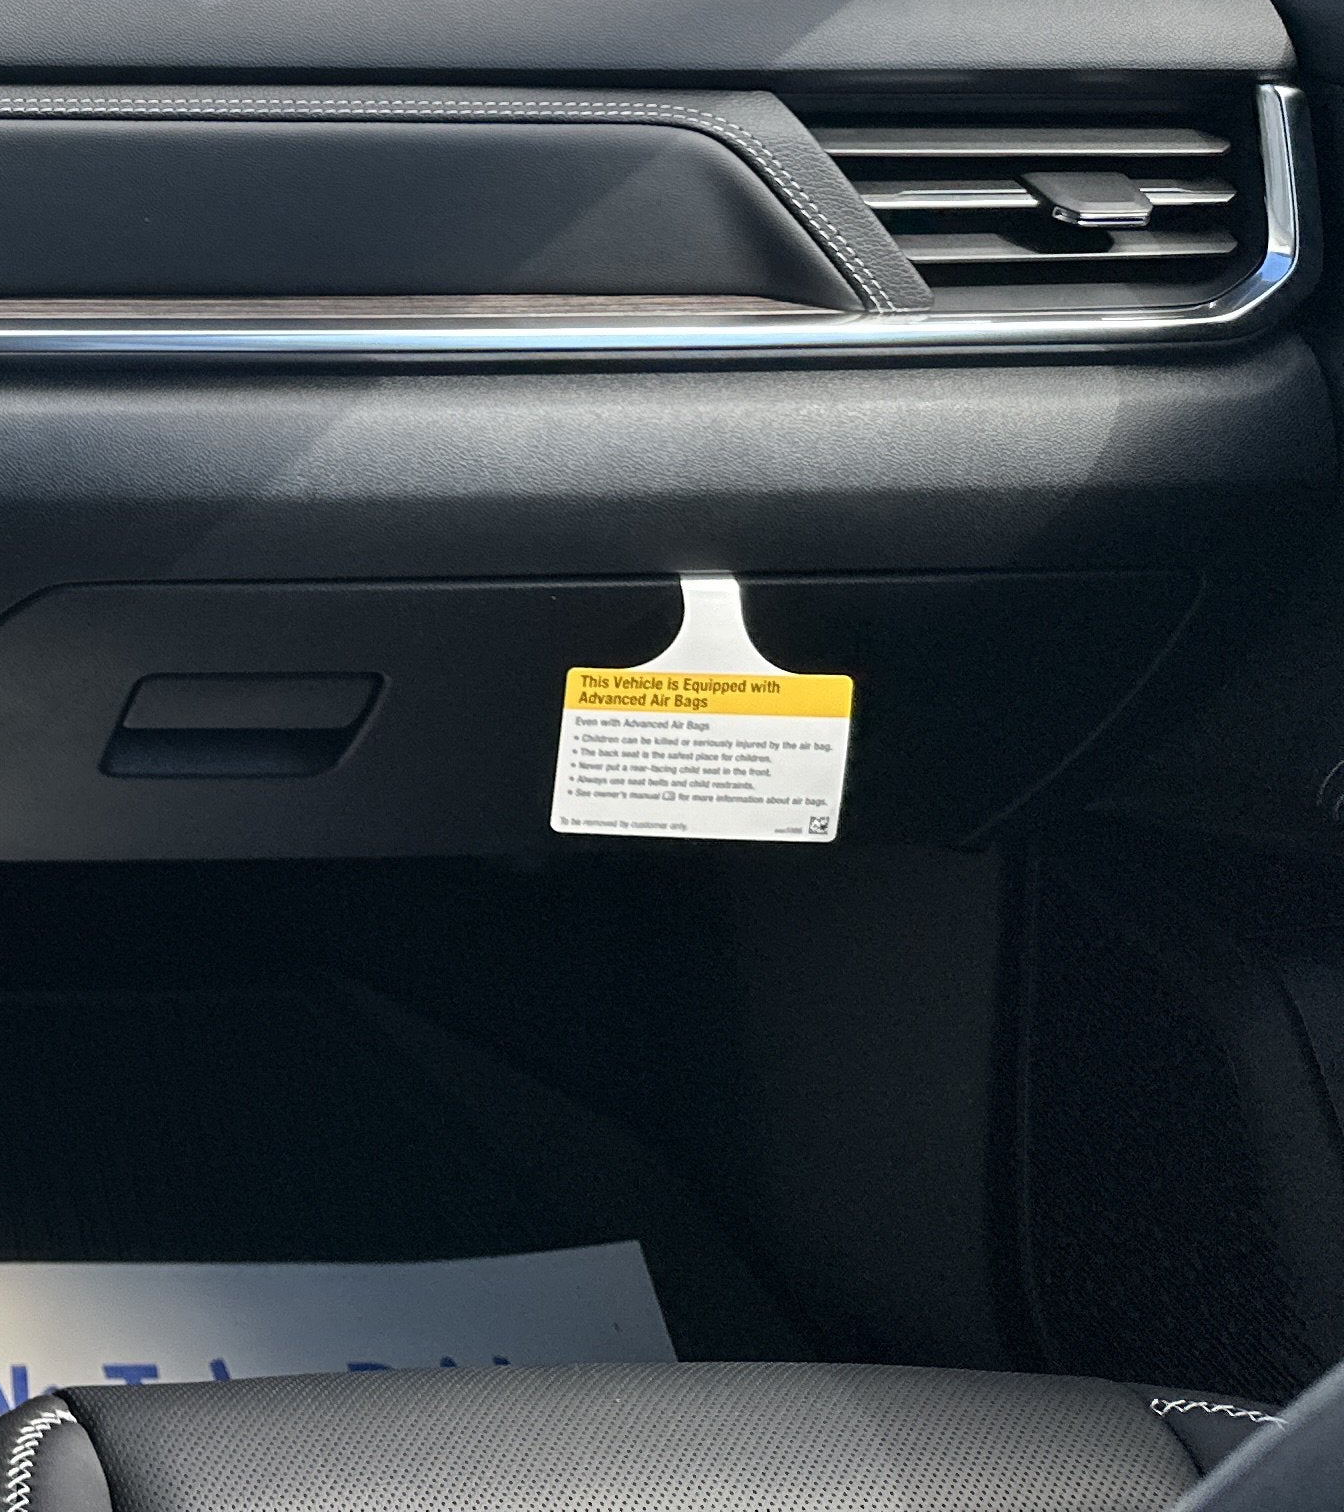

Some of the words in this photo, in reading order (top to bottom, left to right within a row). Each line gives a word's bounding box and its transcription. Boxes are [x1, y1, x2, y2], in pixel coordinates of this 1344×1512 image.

[581, 675, 609, 688] This
[613, 676, 663, 690] Vehicle
[667, 678, 679, 691] is
[683, 678, 746, 695] Equipped
[751, 680, 780, 694] with
[578, 692, 646, 706] Advanced
[650, 694, 671, 707] Air
[674, 695, 708, 710] Bags
[575, 717, 598, 726] Even
[600, 719, 621, 727] with
[623, 719, 668, 729] Advanced
[671, 720, 684, 729] Air
[686, 721, 710, 732] Bags
[582, 734, 619, 743] Children
[621, 736, 638, 744] can
[640, 736, 651, 745] be
[654, 737, 679, 746] killed
[693, 740, 733, 749] seriously
[736, 740, 767, 749] injured
[769, 740, 779, 751] by
[782, 741, 797, 749] the
[799, 742, 811, 750] air
[814, 742, 832, 752] bag.
[581, 748, 596, 757] The
[598, 749, 618, 757] back
[621, 750, 639, 758] seat
[642, 750, 649, 758] is
[652, 750, 665, 759] the
[668, 751, 693, 760] safest
[695, 752, 719, 761] place
[721, 753, 733, 761] for
[735, 753, 771, 763] children.
